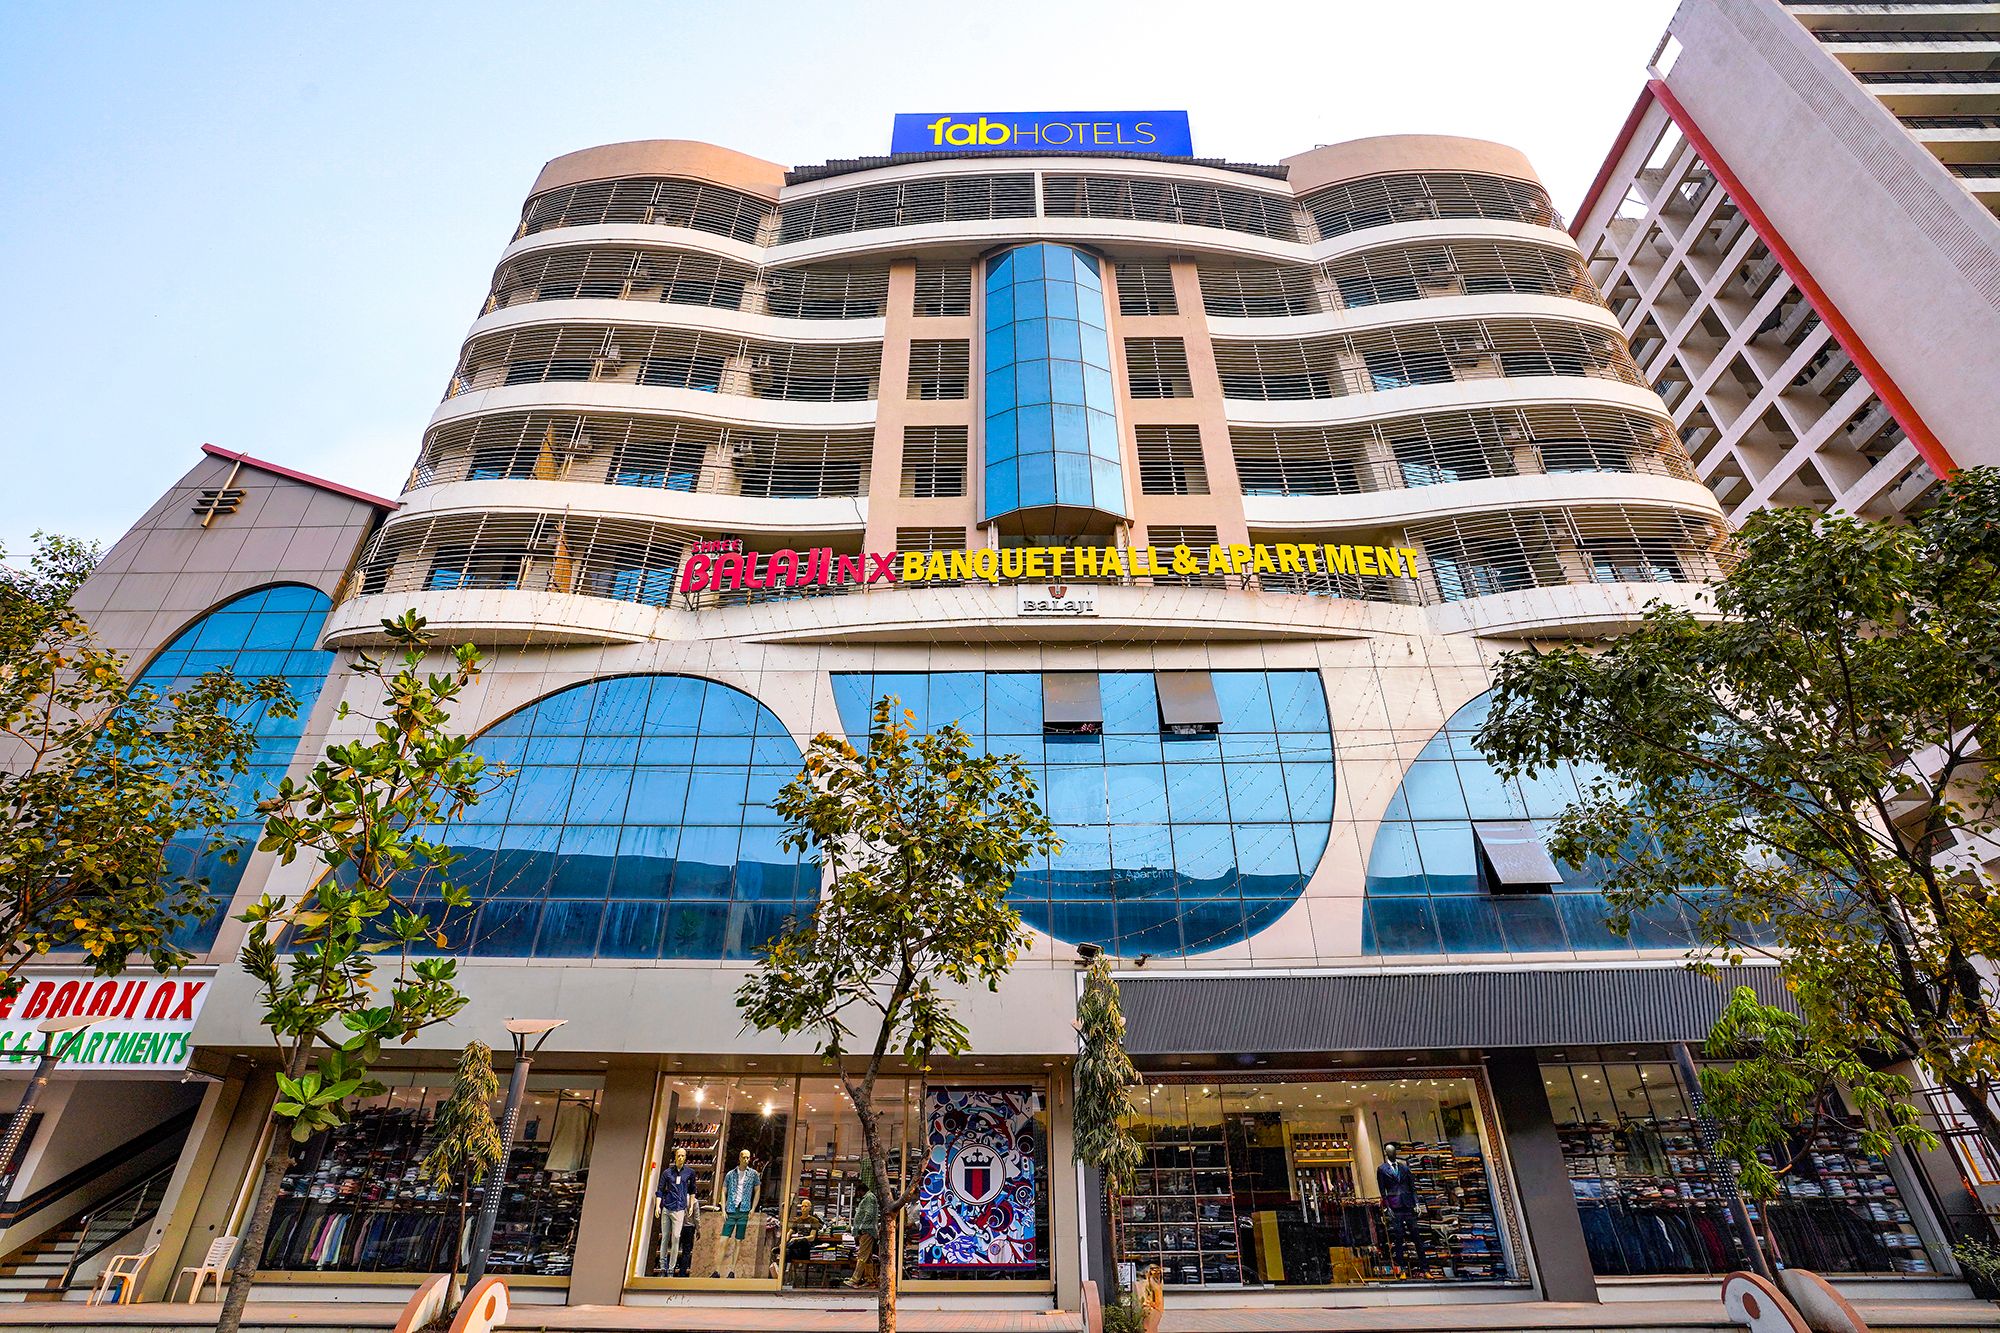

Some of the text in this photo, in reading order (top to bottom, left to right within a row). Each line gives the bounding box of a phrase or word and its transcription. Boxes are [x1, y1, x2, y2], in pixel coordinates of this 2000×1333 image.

[692, 539, 742, 553] SHREE
[903, 546, 1067, 583] BANQUET
[1074, 546, 1169, 577] HALL
[1172, 544, 1201, 575] &
[1208, 543, 1419, 579] APARTMENT
[21, 981, 149, 1019] BALAJI
